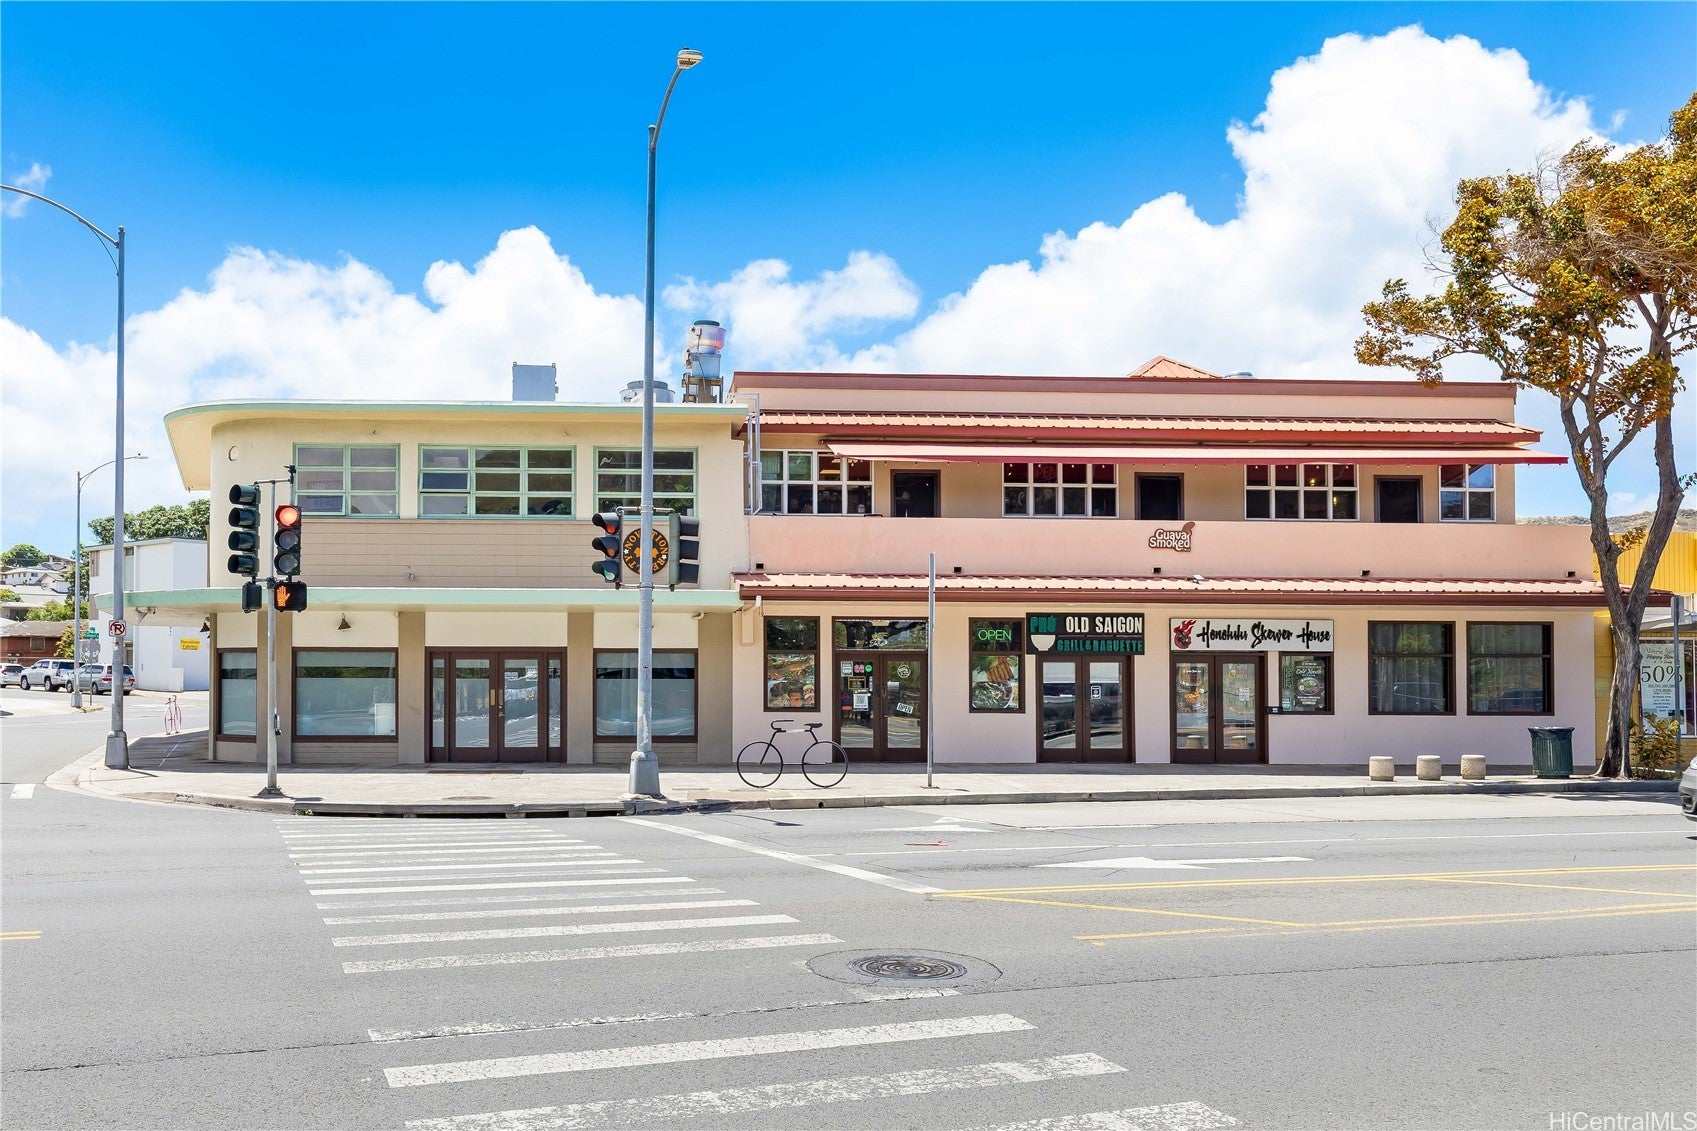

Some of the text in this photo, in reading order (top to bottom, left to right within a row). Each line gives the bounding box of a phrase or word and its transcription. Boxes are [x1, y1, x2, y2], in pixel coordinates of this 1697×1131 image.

[1149, 533, 1191, 550] Smoked
[1156, 529, 1187, 540] Guava
[624, 555, 665, 573] RETY
[1065, 616, 1090, 633] OLD
[1095, 616, 1143, 633] SAIGON
[978, 629, 1012, 641] OPEN
[1196, 620, 1331, 649] Honolulu Skewer House
[1641, 665, 1683, 683] 50%
